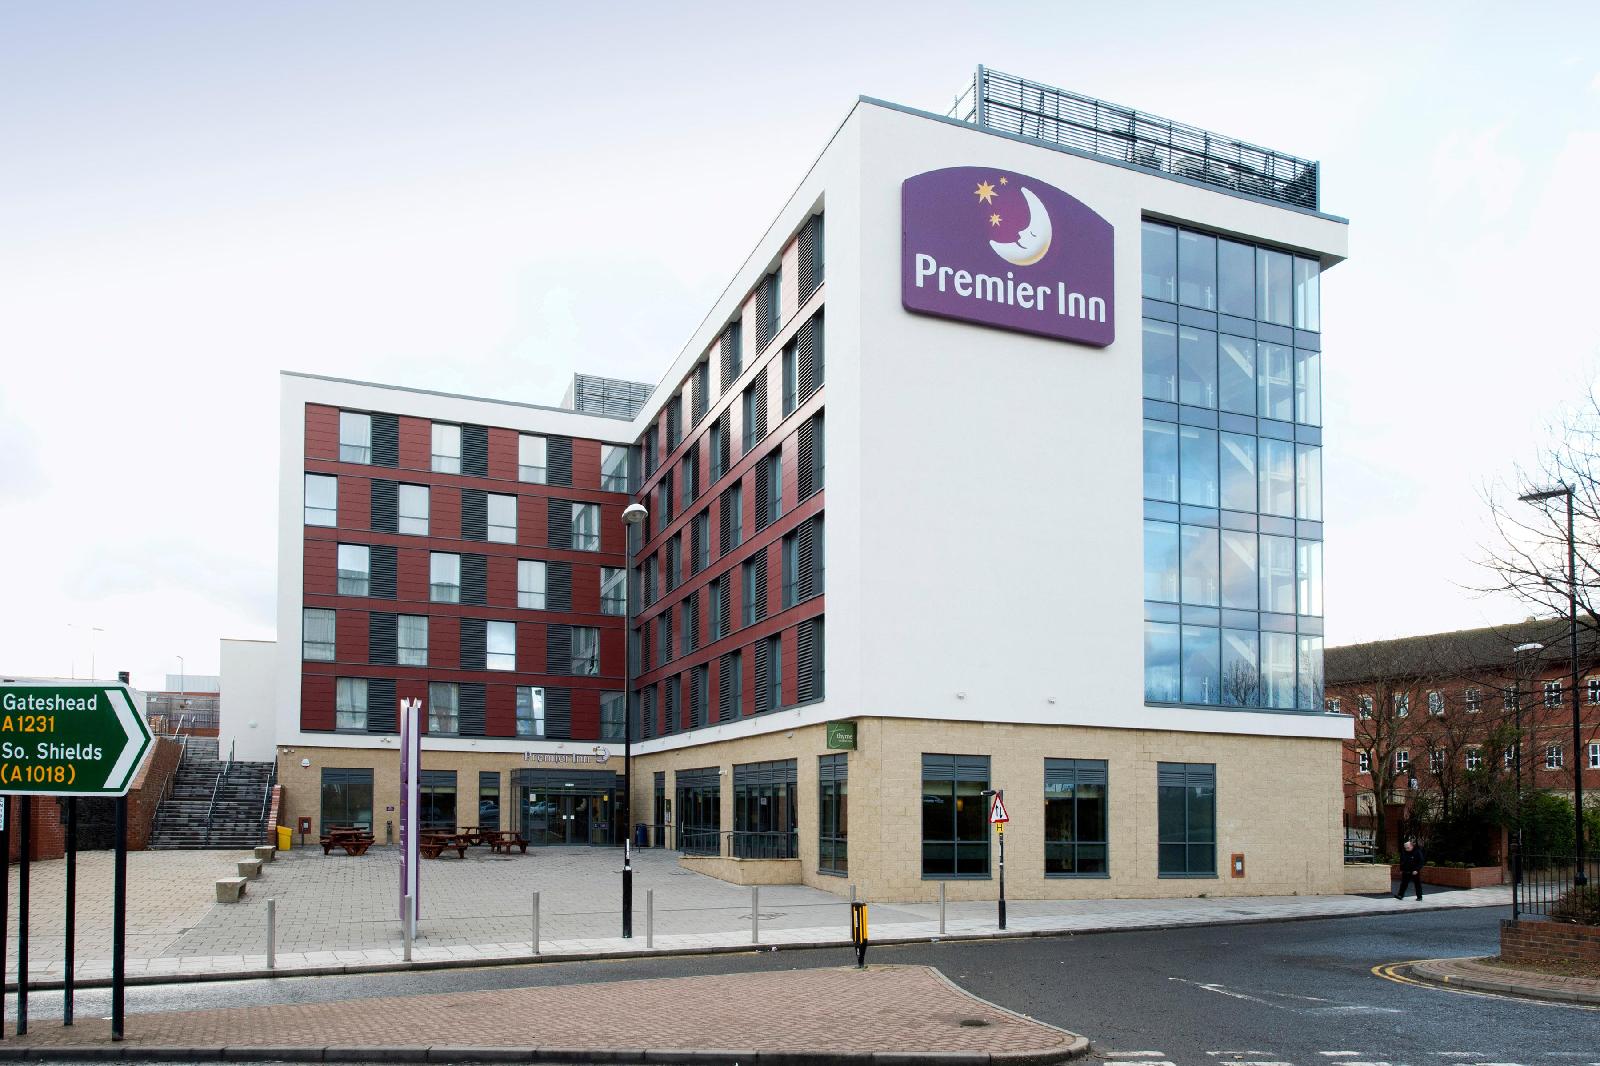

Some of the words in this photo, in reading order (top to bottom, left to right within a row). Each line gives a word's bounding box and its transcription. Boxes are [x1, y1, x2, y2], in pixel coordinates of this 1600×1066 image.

[915, 253, 1051, 310] Premier
[1058, 281, 1106, 323] Inn
[3, 693, 98, 711] Gateshead
[1, 715, 55, 732] A1231
[1, 742, 29, 759] So.
[37, 742, 103, 760] Shields
[524, 751, 569, 763] Premier
[573, 752, 591, 764] Inn
[0, 763, 76, 785] (A1018)
